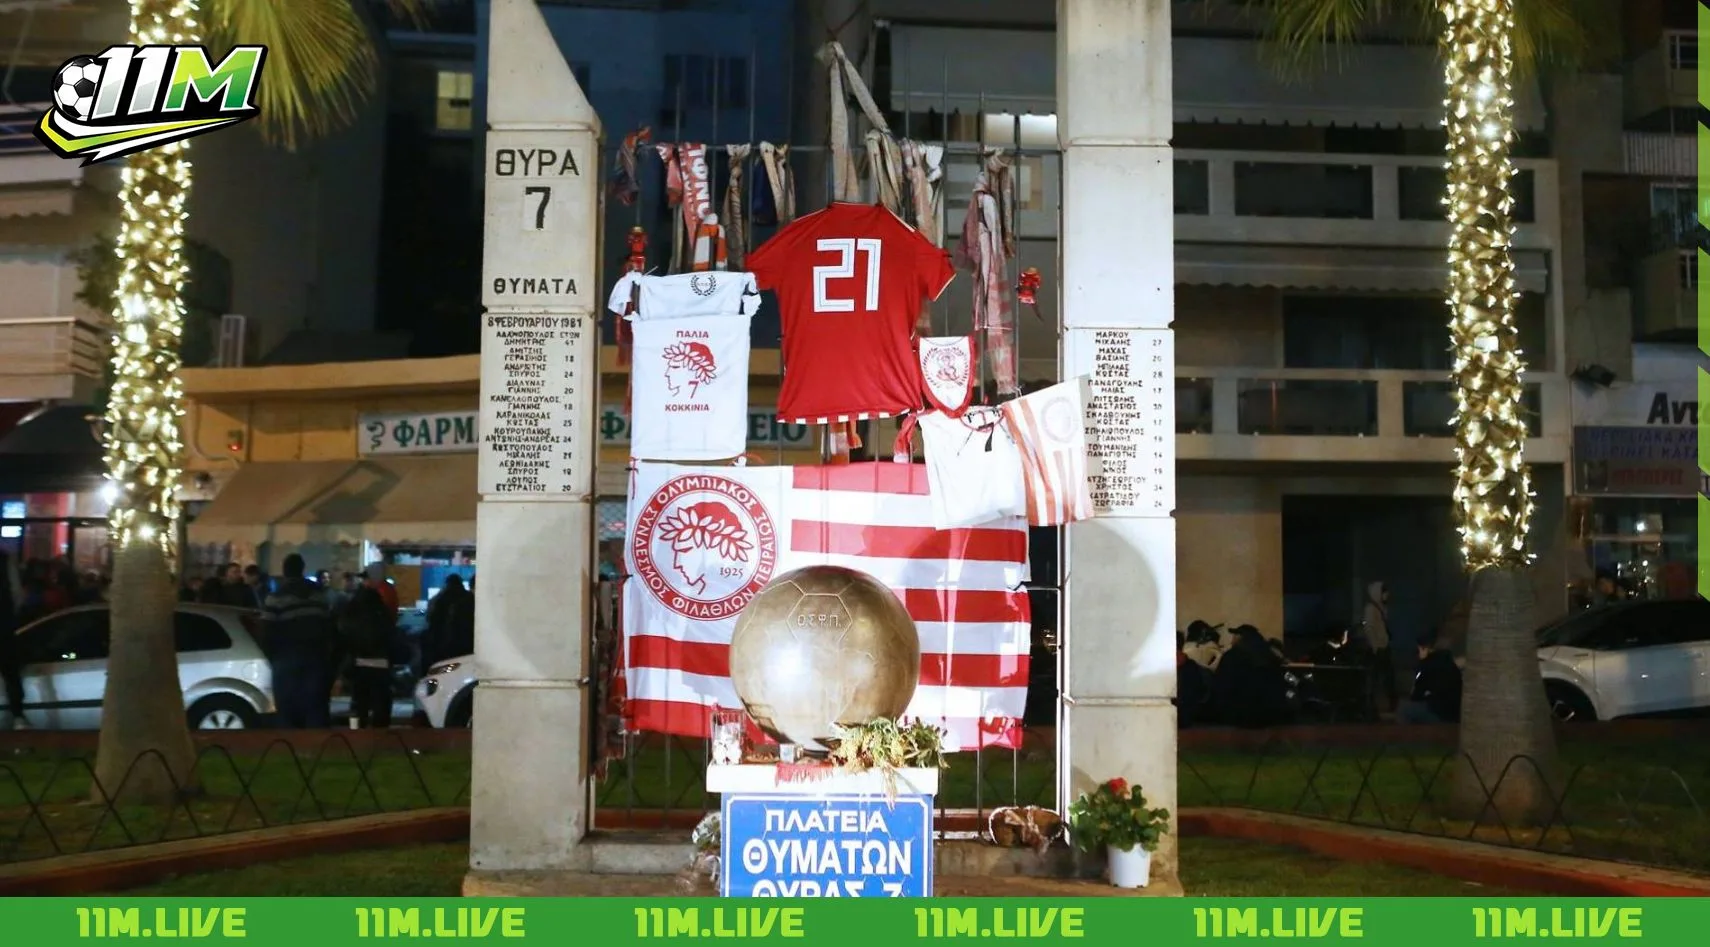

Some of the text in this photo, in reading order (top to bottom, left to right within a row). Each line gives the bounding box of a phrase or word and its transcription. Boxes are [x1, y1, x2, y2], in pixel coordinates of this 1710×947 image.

[495, 149, 580, 176] ΘΥΡΑ
[525, 186, 551, 229] 7
[493, 277, 577, 295] ΘΥΜΑΤΑ
[813, 238, 881, 312] 21
[560, 318, 582, 328] 1981
[676, 330, 709, 338] ΠΑΛΙΑ
[688, 381, 699, 399] 7
[393, 416, 479, 447] ΦΑΡΜ
[635, 477, 774, 616] ΟΛΥΜΠΙΑΚΟΣ ΣΥΝΔΕΣΜΟΣ ΦΙΛΑΘΛΩΝ ΠΕΙΡΑΙΩΣ
[719, 567, 744, 578] 1925
[765, 809, 888, 832] ΠΛΑΤΕΙΑ
[742, 838, 911, 874] ΘΥΜΑΤΩΝ
